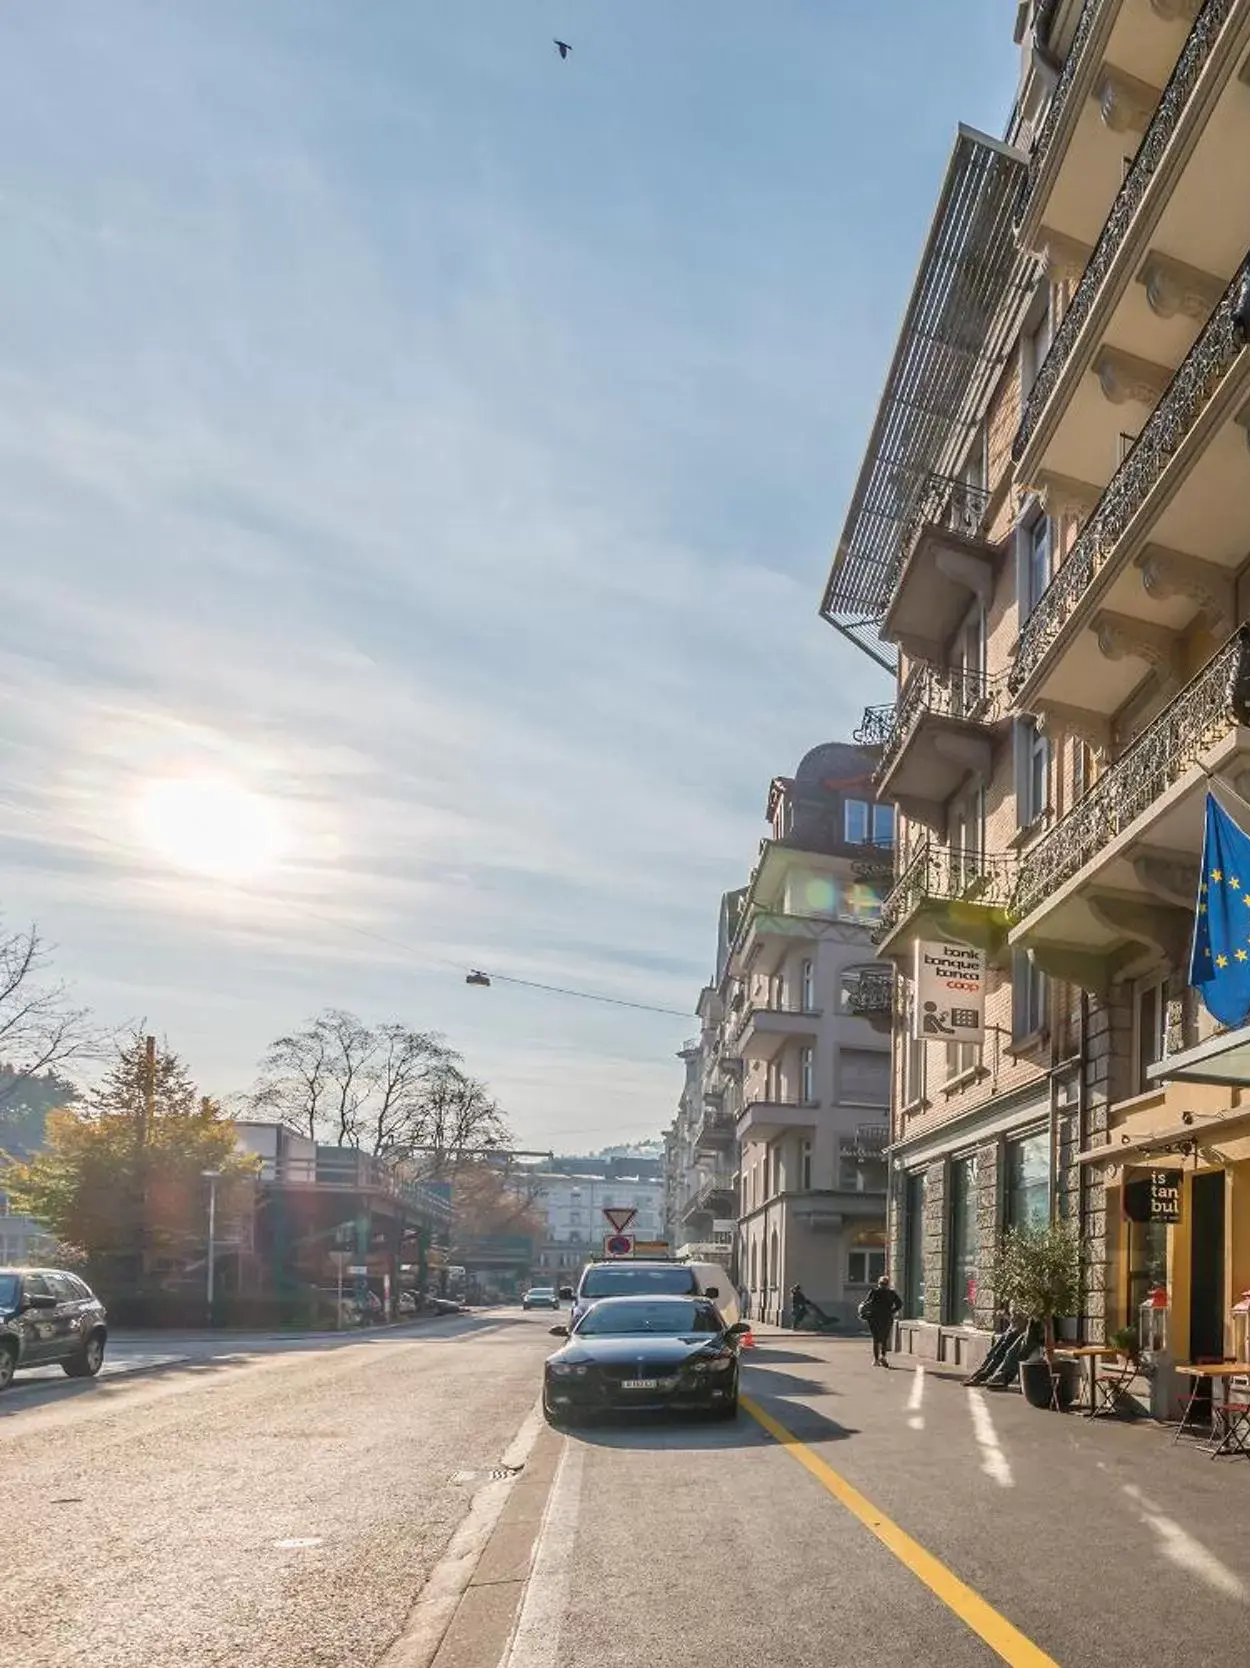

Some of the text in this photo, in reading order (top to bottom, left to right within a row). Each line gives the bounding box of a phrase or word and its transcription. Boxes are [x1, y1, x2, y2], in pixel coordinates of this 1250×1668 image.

[944, 946, 979, 960] bank
[924, 954, 979, 970] banque
[936, 967, 979, 981] banca
[946, 981, 979, 992] coop
[1151, 1171, 1166, 1184] is
[1151, 1184, 1179, 1198] tan
[1151, 1199, 1179, 1213] bul
